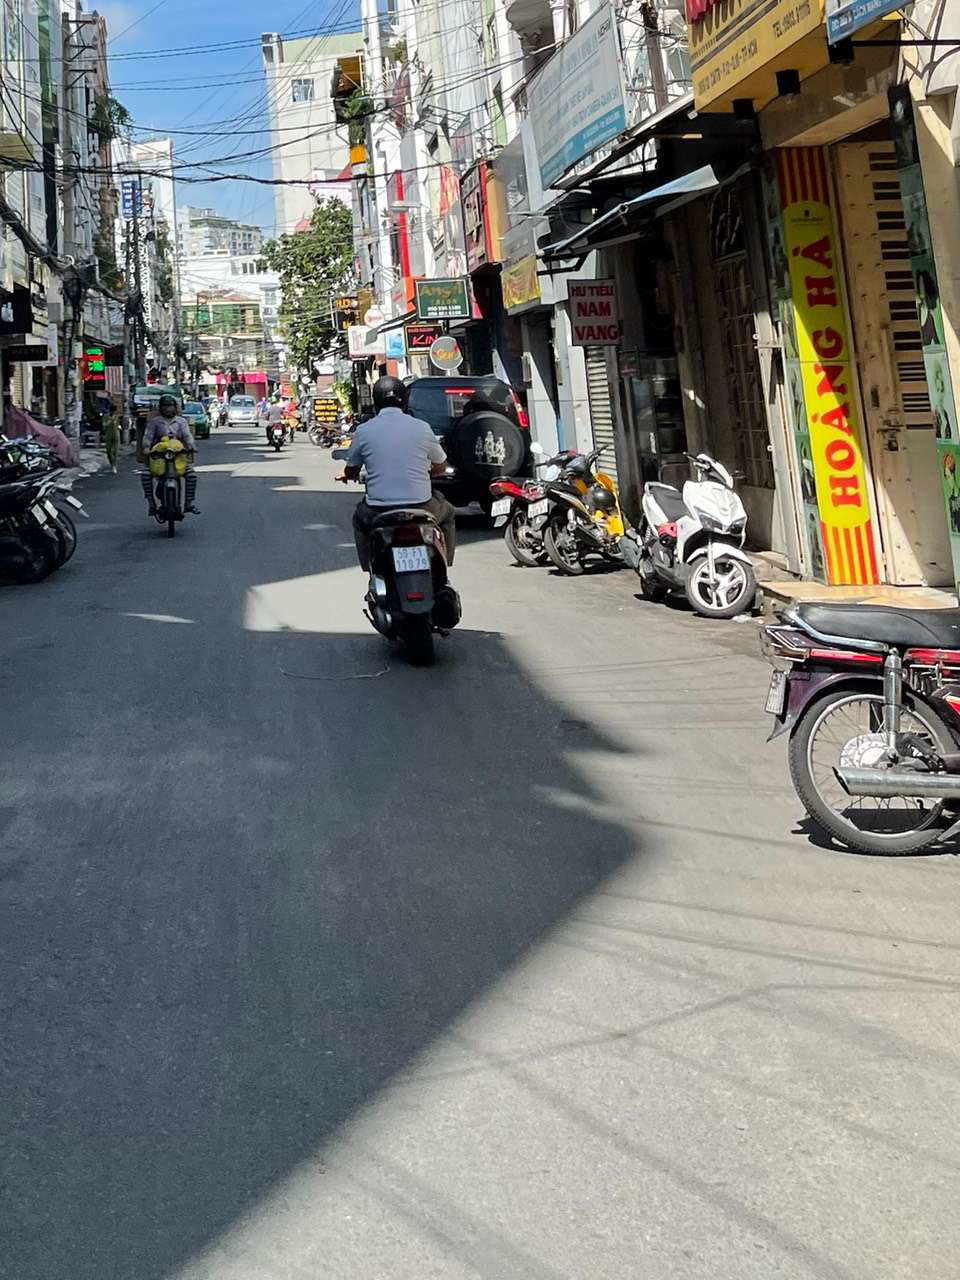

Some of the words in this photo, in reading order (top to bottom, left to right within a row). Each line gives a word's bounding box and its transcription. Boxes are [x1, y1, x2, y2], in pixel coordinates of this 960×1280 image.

[792, 234, 838, 308] HÀ
[576, 301, 612, 318] NAM
[574, 324, 618, 341] VANG
[810, 325, 862, 509] HOÀNG
